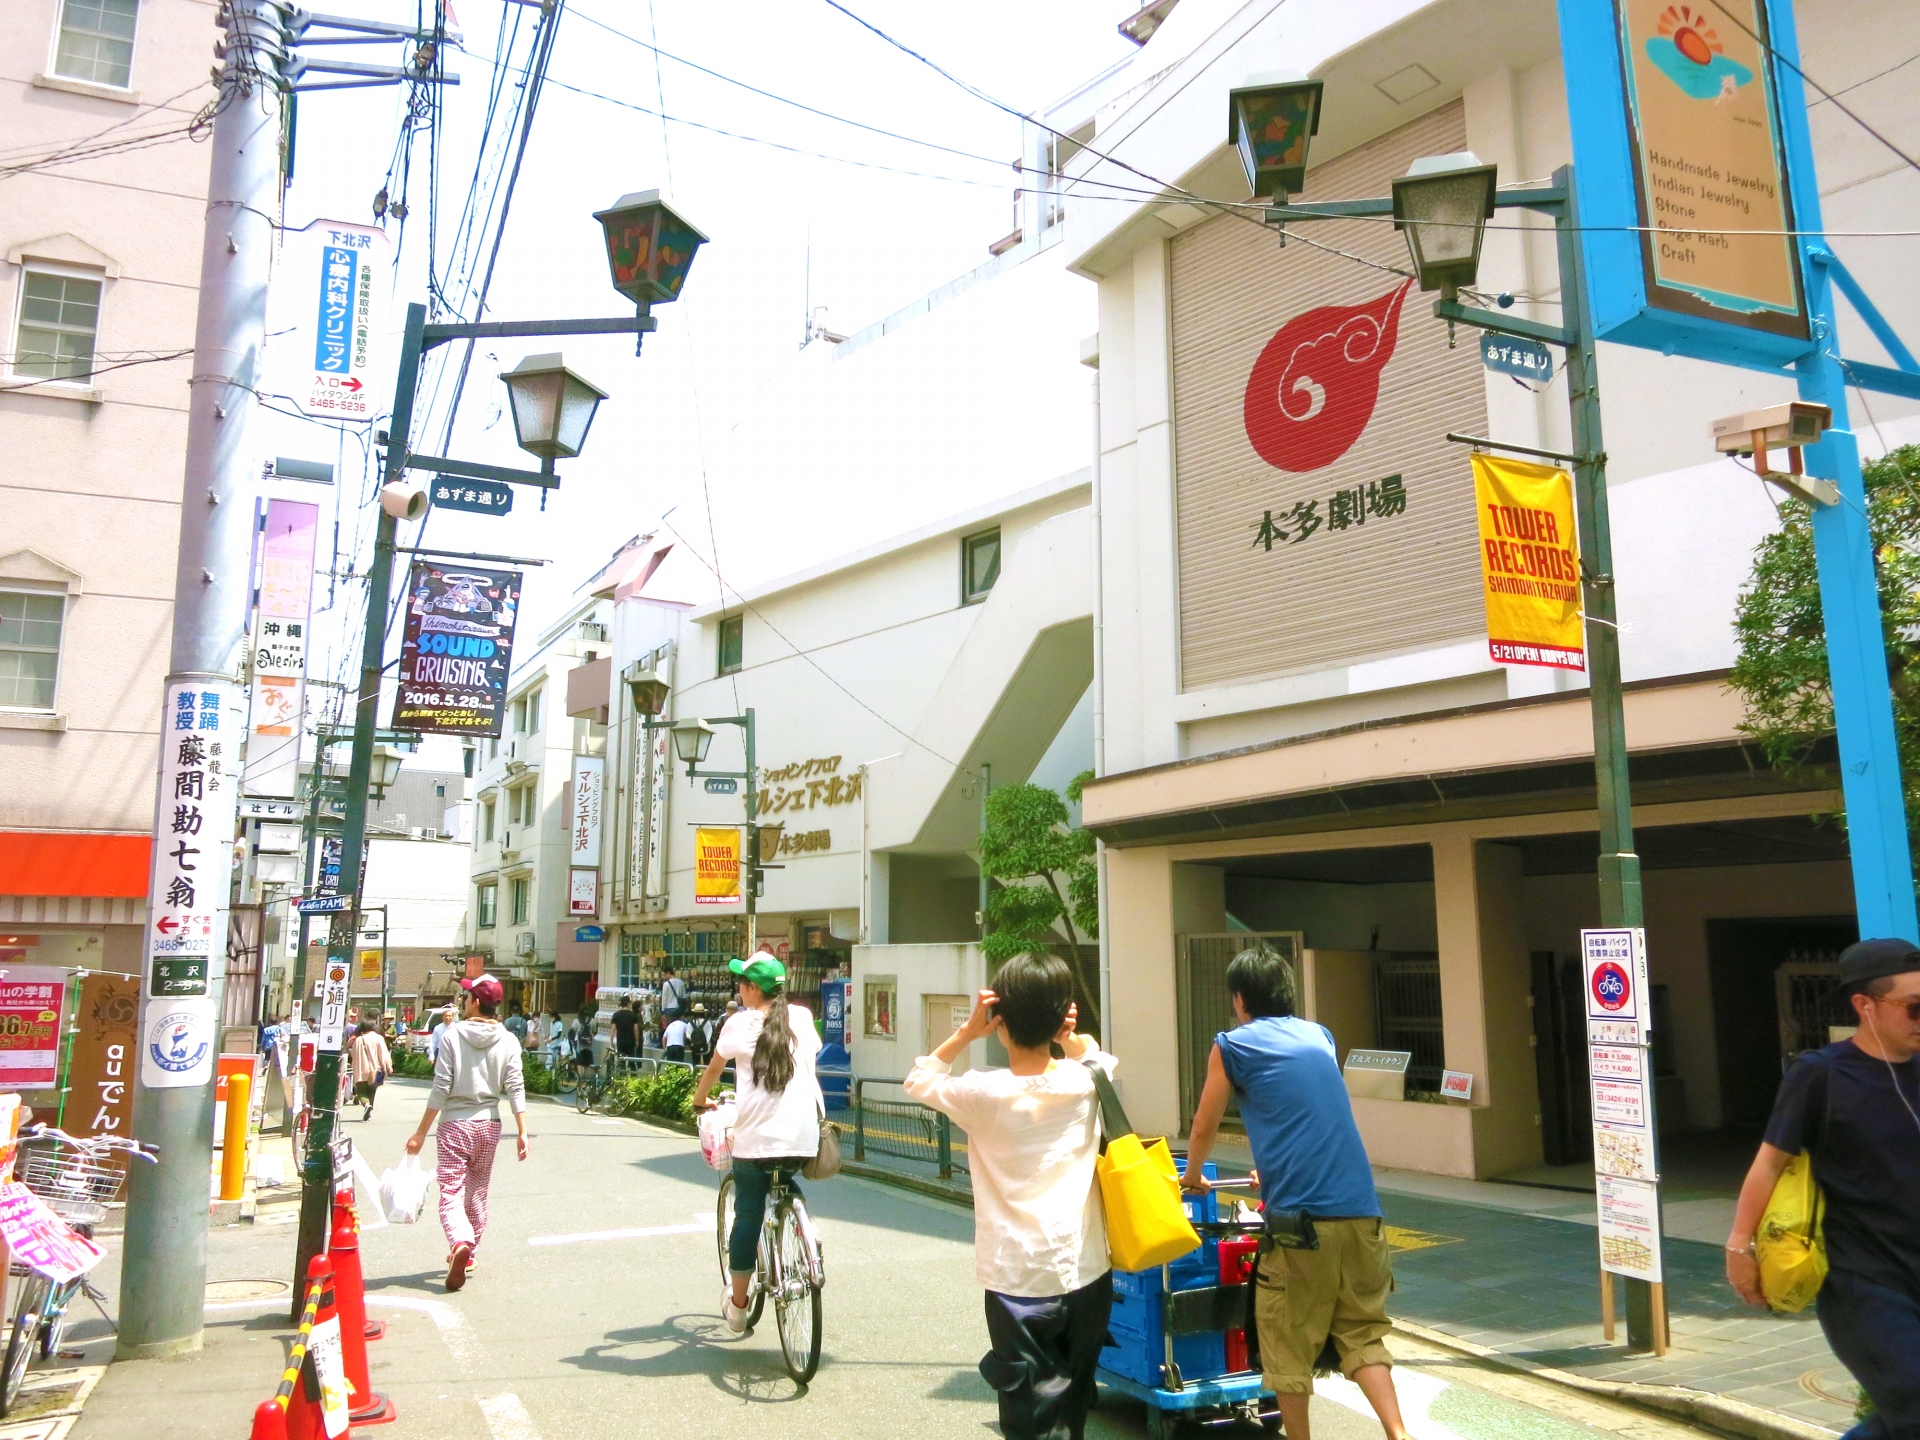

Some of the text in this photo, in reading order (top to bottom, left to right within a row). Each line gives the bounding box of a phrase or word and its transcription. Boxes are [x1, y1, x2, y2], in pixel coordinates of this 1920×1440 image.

[1650, 149, 1774, 199] Handmade Jewelry
[1652, 173, 1750, 214] Indian Jewelry
[1655, 196, 1696, 219] Stone
[328, 230, 371, 249] 下北沢
[1661, 243, 1696, 264] Craft
[322, 249, 351, 371] 心療内科クリニック
[1487, 344, 1549, 371] あずま通り
[314, 376, 340, 388] 入口
[309, 398, 366, 412] 5465-5238
[311, 389, 365, 402] ハイタウン4F
[436, 486, 508, 506] あずま通り
[1249, 473, 1407, 552] 本多劇場
[1488, 504, 1560, 545] TOWER
[1485, 538, 1576, 582] RECORDS
[1488, 575, 1578, 603] SHIMOKITAZAWA
[264, 621, 302, 637] 沖縄
[423, 616, 496, 635] Shimokitazawa
[416, 632, 495, 658] SOUND
[415, 656, 490, 688] CRUISING
[174, 691, 197, 731] 教授
[198, 691, 220, 731] 舞踊
[763, 755, 842, 784] ショッピングフロア
[251, 803, 293, 815] 辻ビル
[590, 771, 600, 829] ショッピングフロア
[574, 770, 592, 852] マルシェ下北沢
[165, 736, 208, 909] 藤間勘七翁
[702, 846, 732, 858] TOWER
[779, 829, 831, 855] 本多劇場
[698, 859, 738, 872] RECORDS
[181, 915, 211, 925] すぐ先
[181, 925, 211, 936] 右側
[1588, 938, 1628, 947] 自転車・バイク
[159, 965, 200, 977] 北沢
[826, 1020, 842, 1029] BOSS
[326, 1035, 333, 1044] 8
[1350, 1054, 1403, 1066] 下北沢ハイタウン
[1596, 1093, 1639, 1105] 03(3424)4191
